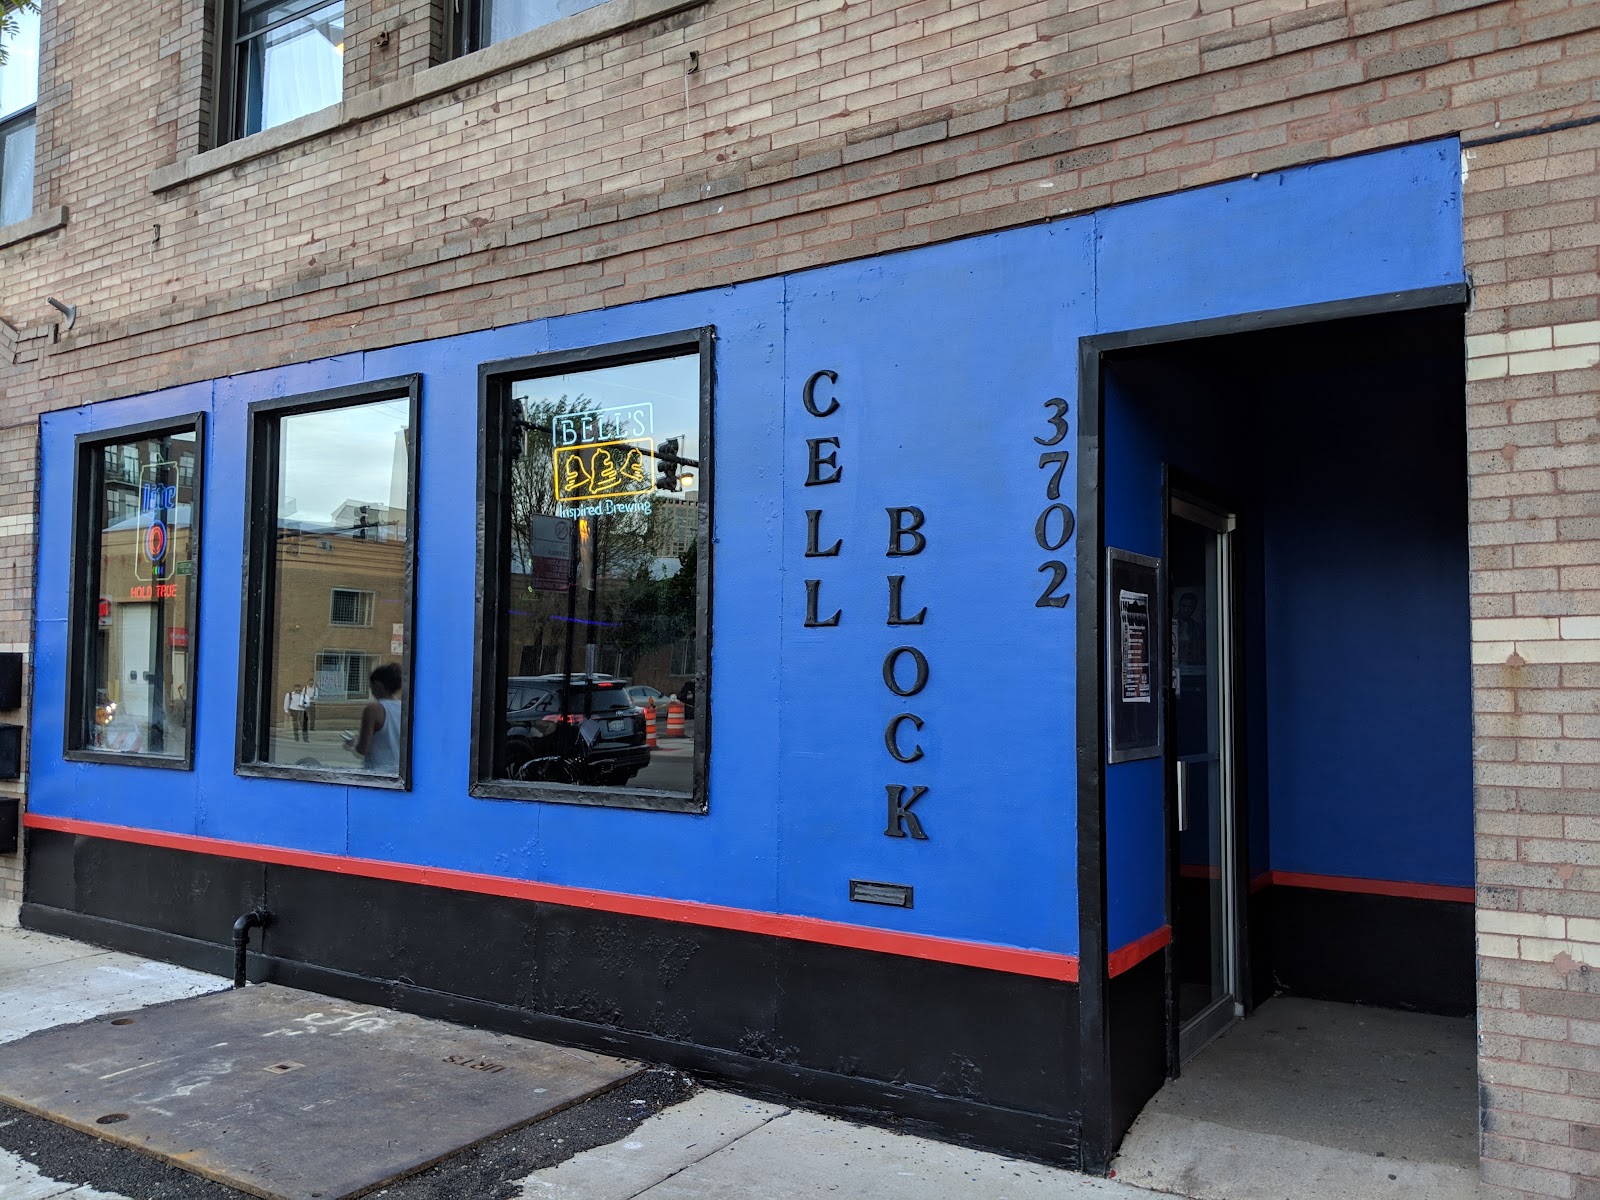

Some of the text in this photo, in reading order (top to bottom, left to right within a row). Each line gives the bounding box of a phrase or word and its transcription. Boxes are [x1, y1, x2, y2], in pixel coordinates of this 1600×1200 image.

[561, 409, 647, 446] BELL'S
[560, 498, 652, 520] Inspired Brewing
[803, 369, 843, 628] CELL
[1034, 397, 1075, 608] 3702
[130, 584, 178, 599] HOLD TRUE
[882, 505, 929, 840] BLOCK
